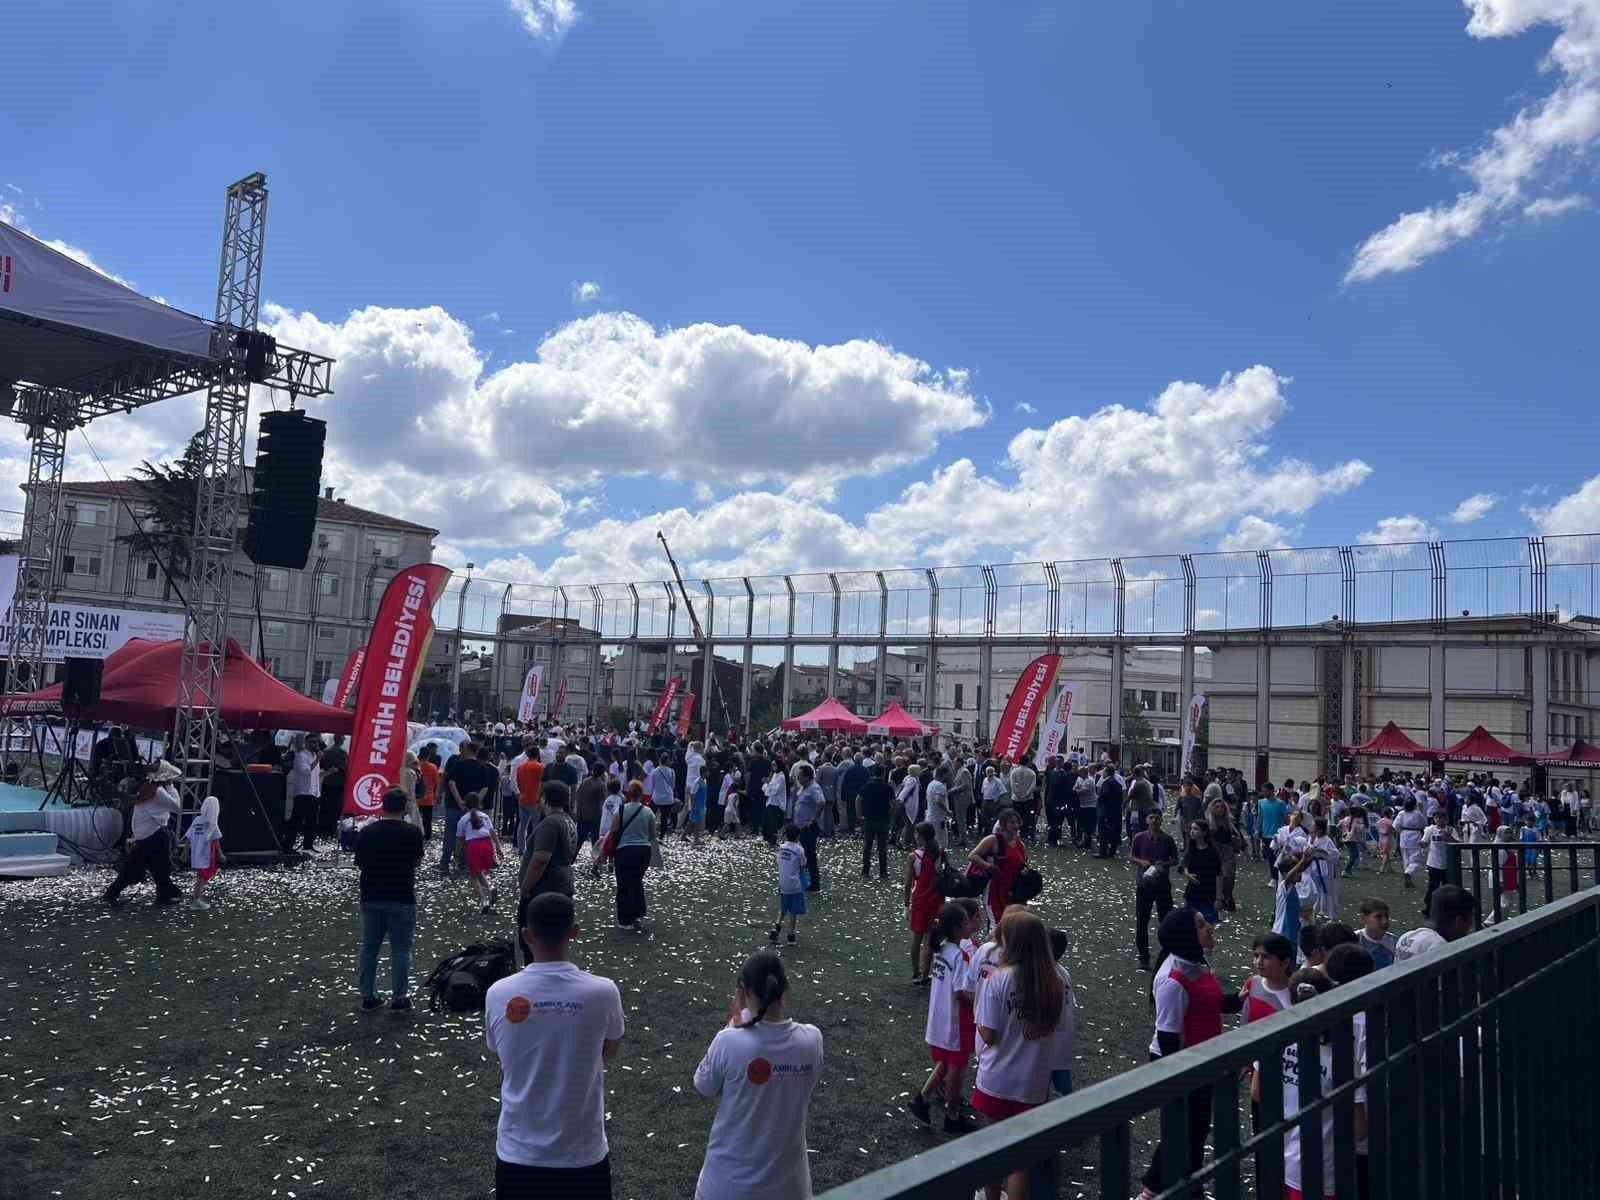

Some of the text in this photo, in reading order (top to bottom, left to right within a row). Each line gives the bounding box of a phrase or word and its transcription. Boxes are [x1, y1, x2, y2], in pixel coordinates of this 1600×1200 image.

[369, 575, 427, 766] FATİH BELEDİYESİ
[1015, 662, 1049, 730] BELEDİYESİ
